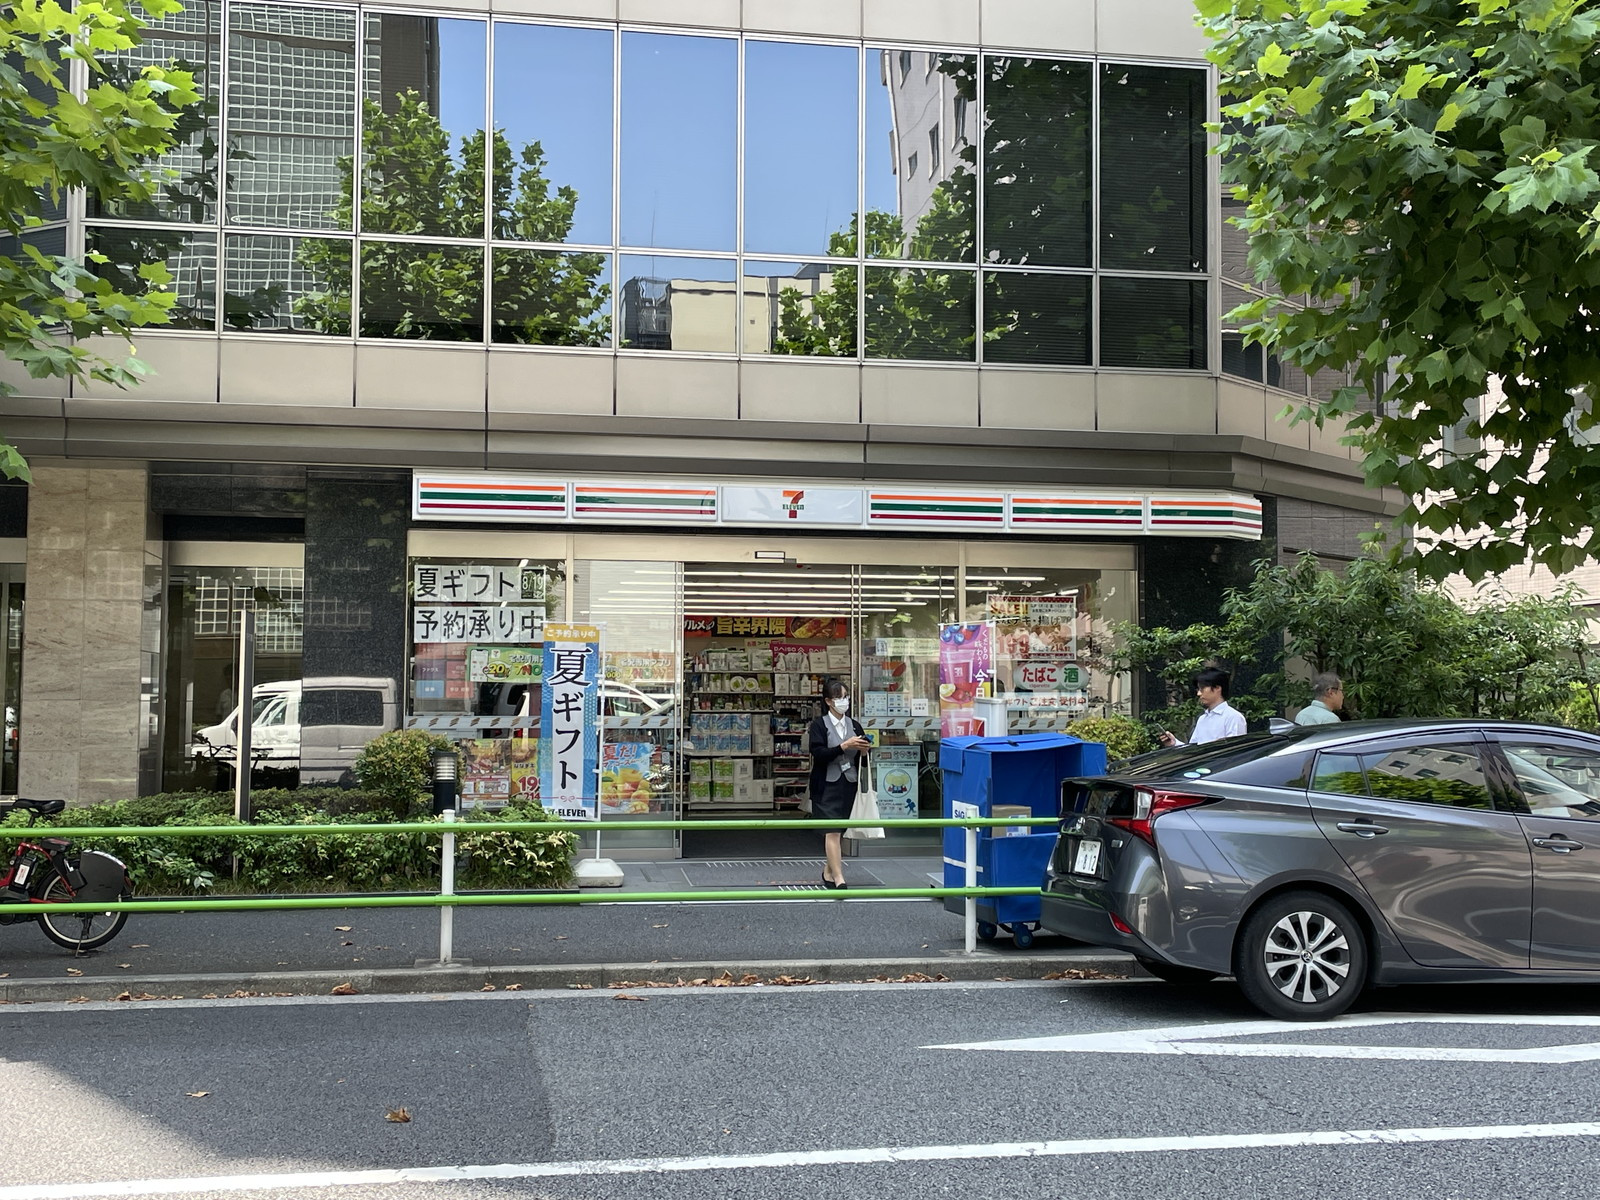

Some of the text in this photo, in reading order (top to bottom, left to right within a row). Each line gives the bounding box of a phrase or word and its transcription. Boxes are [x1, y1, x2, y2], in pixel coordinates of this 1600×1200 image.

[417, 568, 515, 598] 夏ギフト
[522, 576, 543, 590] 8/19
[416, 609, 544, 639] 予約承り中
[716, 616, 786, 635] 旨辛界隈
[546, 629, 596, 639] ご予約承り中
[514, 664, 543, 676] 7NO
[1022, 666, 1079, 683] たばこ 酒
[547, 648, 592, 790] 夏ギフト
[518, 776, 541, 792] 19
